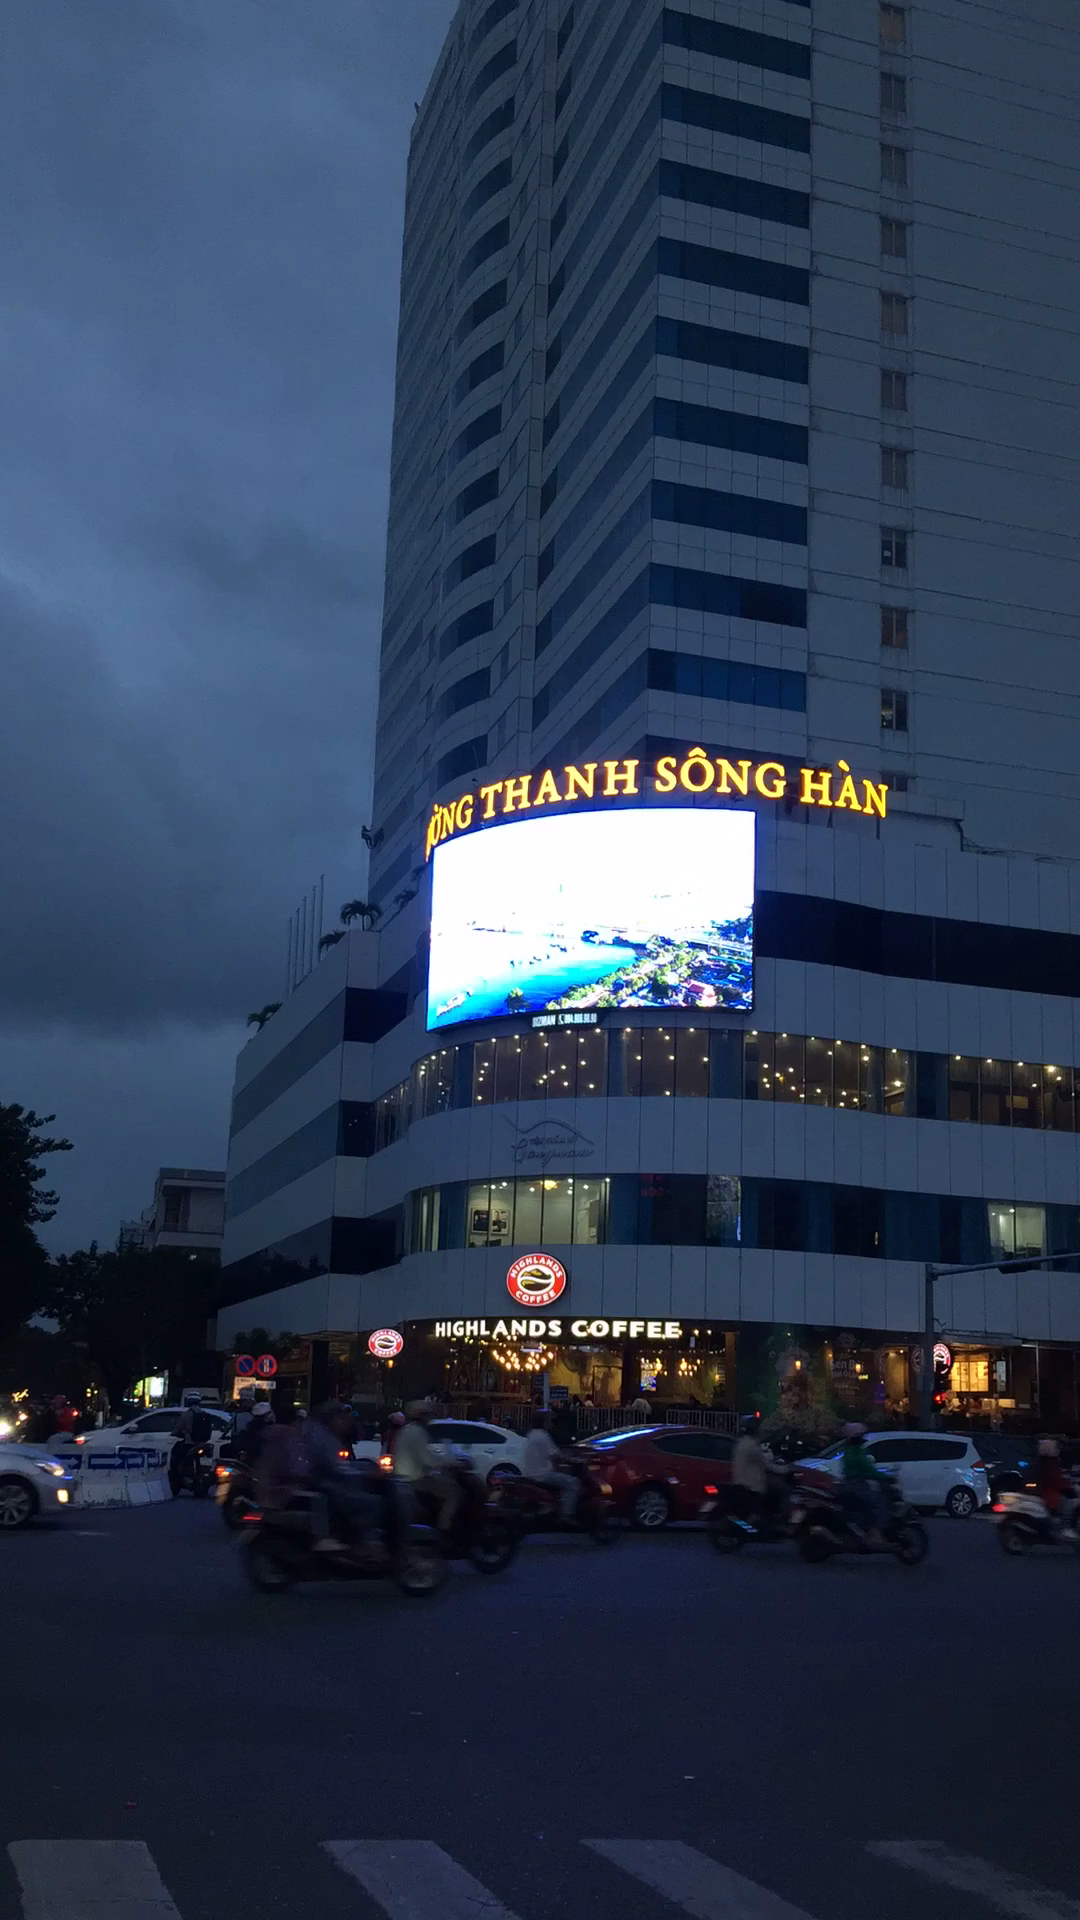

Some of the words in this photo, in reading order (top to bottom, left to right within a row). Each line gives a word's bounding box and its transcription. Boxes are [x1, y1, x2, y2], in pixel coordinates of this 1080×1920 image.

[481, 759, 640, 819] THANH
[655, 747, 787, 798] SÔNG
[799, 760, 889, 818] HÀN
[510, 1256, 563, 1278] HIGHLANDS
[515, 1289, 556, 1303] COFFEE
[435, 1320, 562, 1338] HIGHLANDS
[571, 1320, 681, 1338] COFFEE
